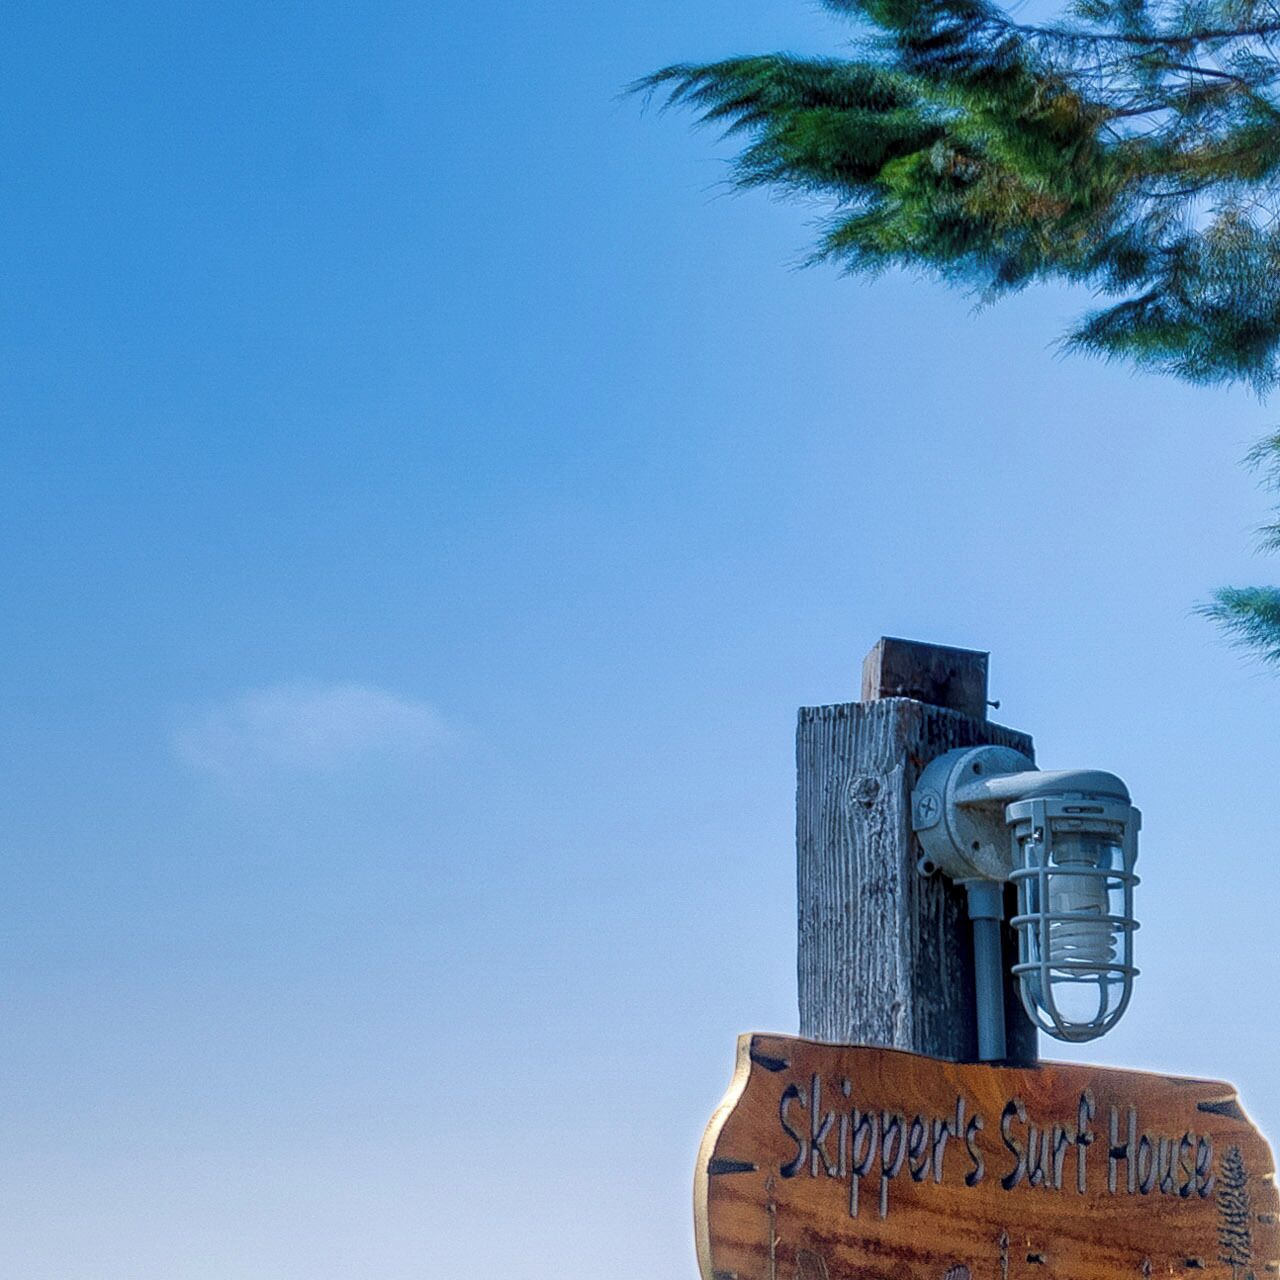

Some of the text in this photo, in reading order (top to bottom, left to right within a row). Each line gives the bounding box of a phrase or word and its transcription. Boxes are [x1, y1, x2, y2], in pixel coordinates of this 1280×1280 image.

[779, 1073, 1216, 1220] Skipper's Surf House
